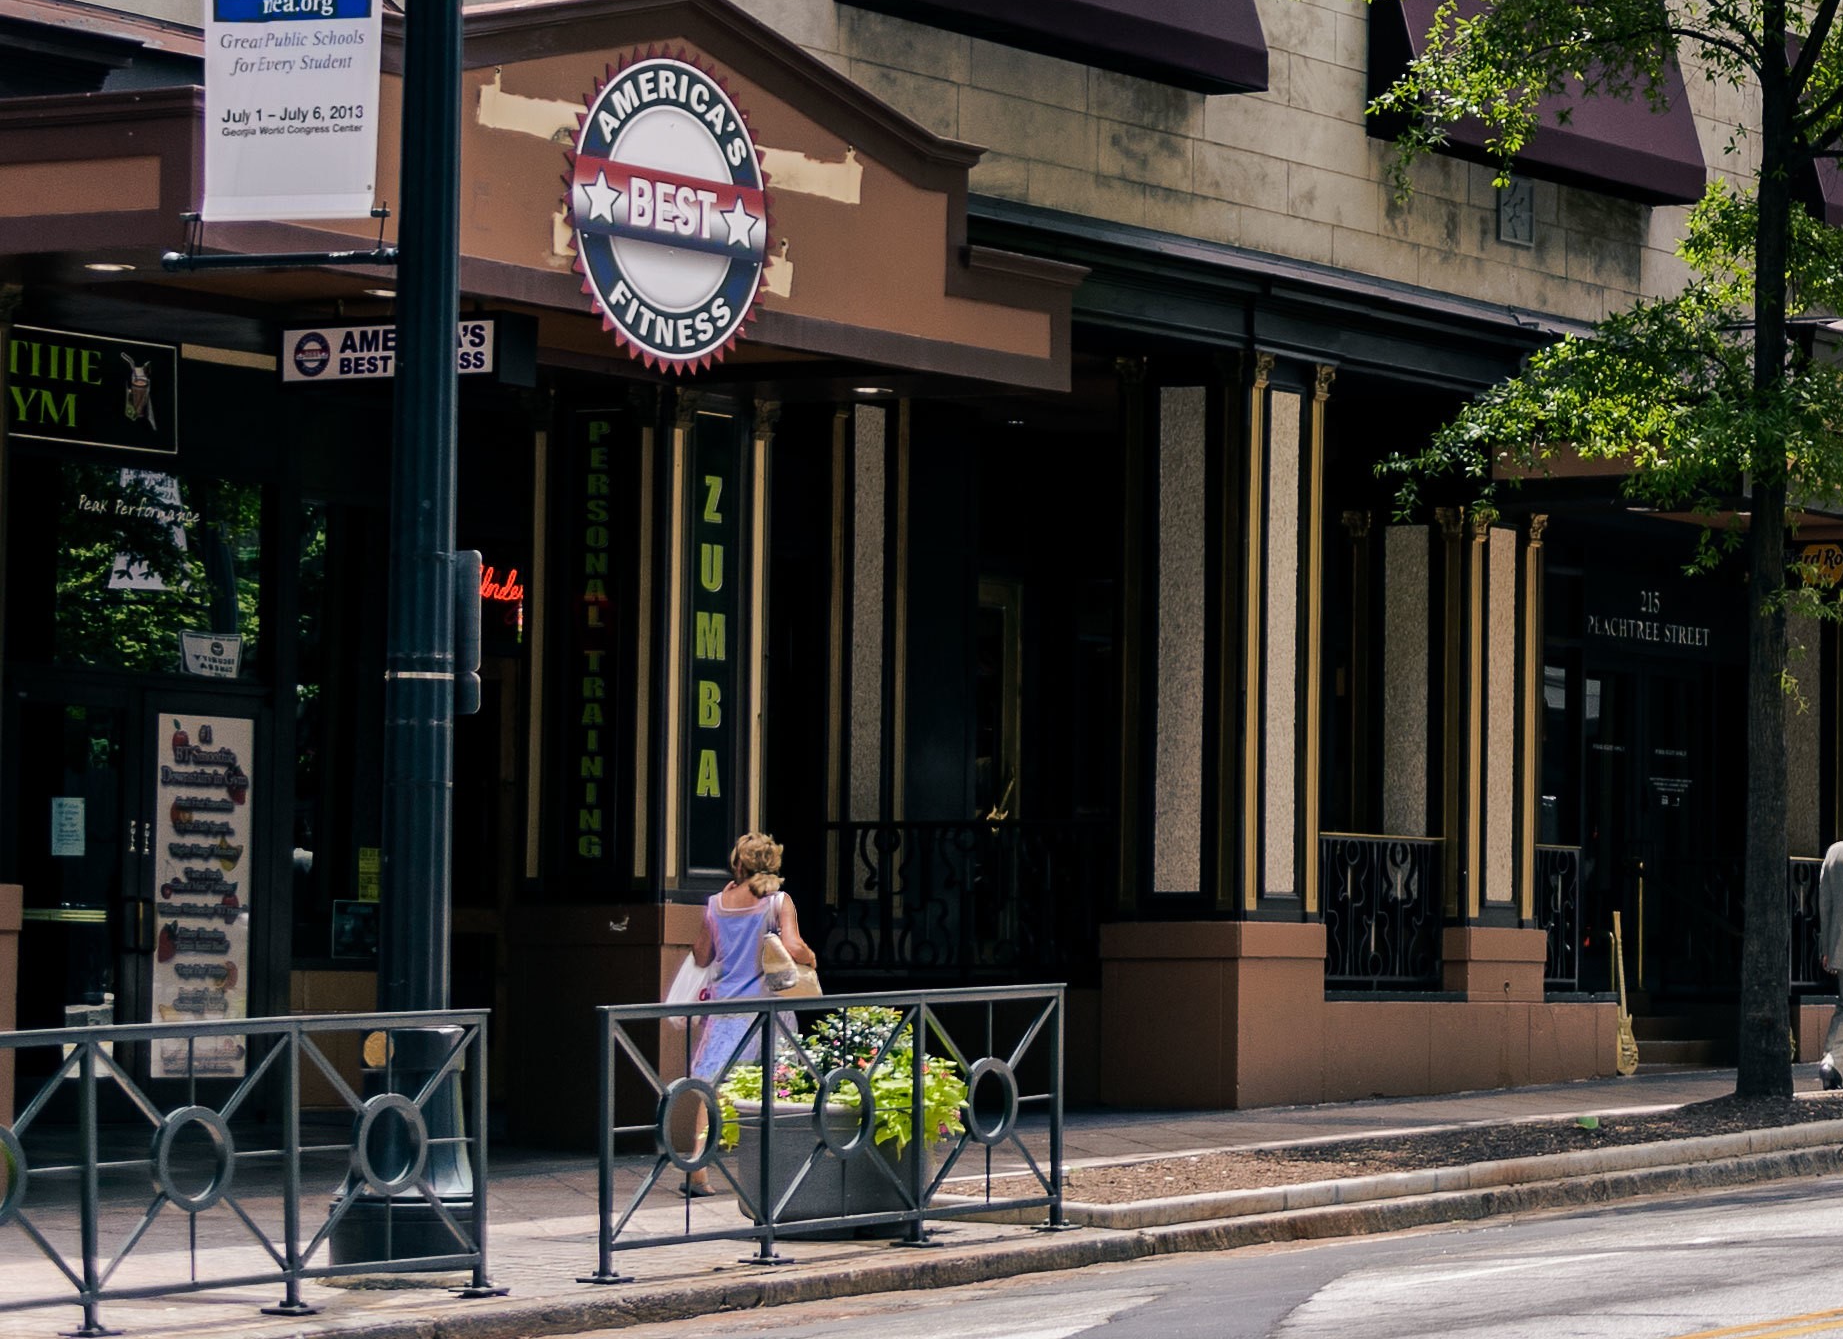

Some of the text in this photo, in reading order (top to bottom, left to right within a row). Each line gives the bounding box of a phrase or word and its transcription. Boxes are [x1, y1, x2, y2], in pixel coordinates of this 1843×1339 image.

[220, 29, 365, 50] Great Public Schools
[229, 54, 353, 76] for Every Student
[222, 107, 250, 126] July
[255, 107, 262, 121] 1
[279, 106, 308, 124] July
[313, 105, 325, 122] 6,
[330, 104, 364, 120] 2013
[598, 69, 748, 168] AMERICA'S
[259, 126, 285, 136] World
[627, 175, 719, 240] BEST
[608, 279, 732, 348] FITNESS
[339, 355, 393, 376] BEST
[78, 493, 201, 524] Peak Performance
[585, 421, 611, 628] PERSONAL
[1640, 590, 1661, 614] 215
[696, 475, 727, 798] ZUMBA
[1587, 615, 1711, 647] PEACHTREE STREET
[577, 649, 605, 859] TRAINING
